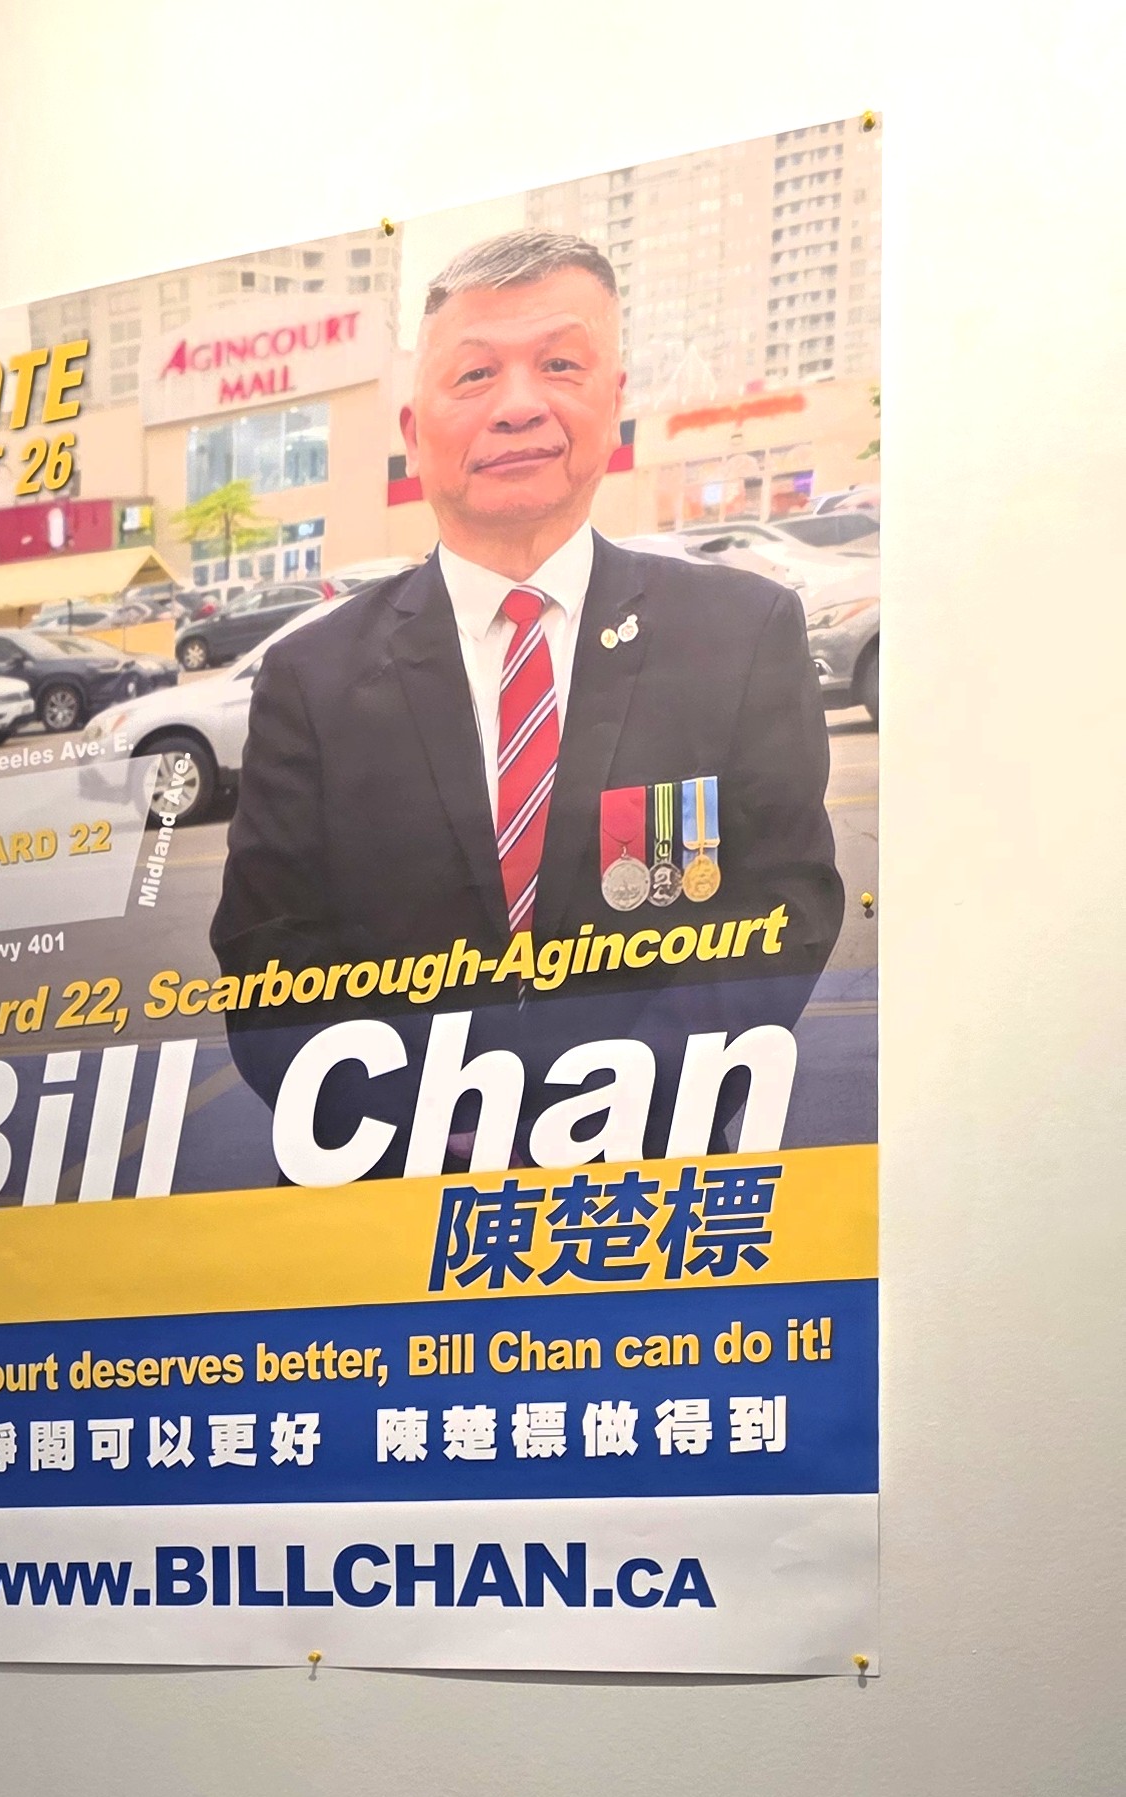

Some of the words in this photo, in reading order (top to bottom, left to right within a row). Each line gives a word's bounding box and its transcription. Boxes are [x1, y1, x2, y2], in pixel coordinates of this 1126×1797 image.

[159, 311, 362, 380] AGINCOURT
[218, 364, 297, 405] MALL
[16, 434, 76, 497] 26
[60, 741, 106, 762] Ave.
[113, 732, 134, 752] E.
[68, 820, 113, 855] 22
[138, 811, 177, 907] Midland
[164, 752, 192, 805] Ave.
[27, 931, 66, 955] 401
[55, 976, 129, 1034] 22,
[144, 905, 791, 1020] Scarborough-Agincourt
[271, 1010, 799, 1191] Chan
[427, 1164, 784, 1293] 陳楚標
[69, 1346, 245, 1391] deserves
[256, 1338, 389, 1390] better,
[407, 1332, 475, 1378] Bill
[486, 1327, 602, 1374] Chan
[614, 1331, 699, 1369] can
[712, 1321, 772, 1366] do
[786, 1315, 834, 1361] it!
[376, 1395, 788, 1463] 陳楚標做得到
